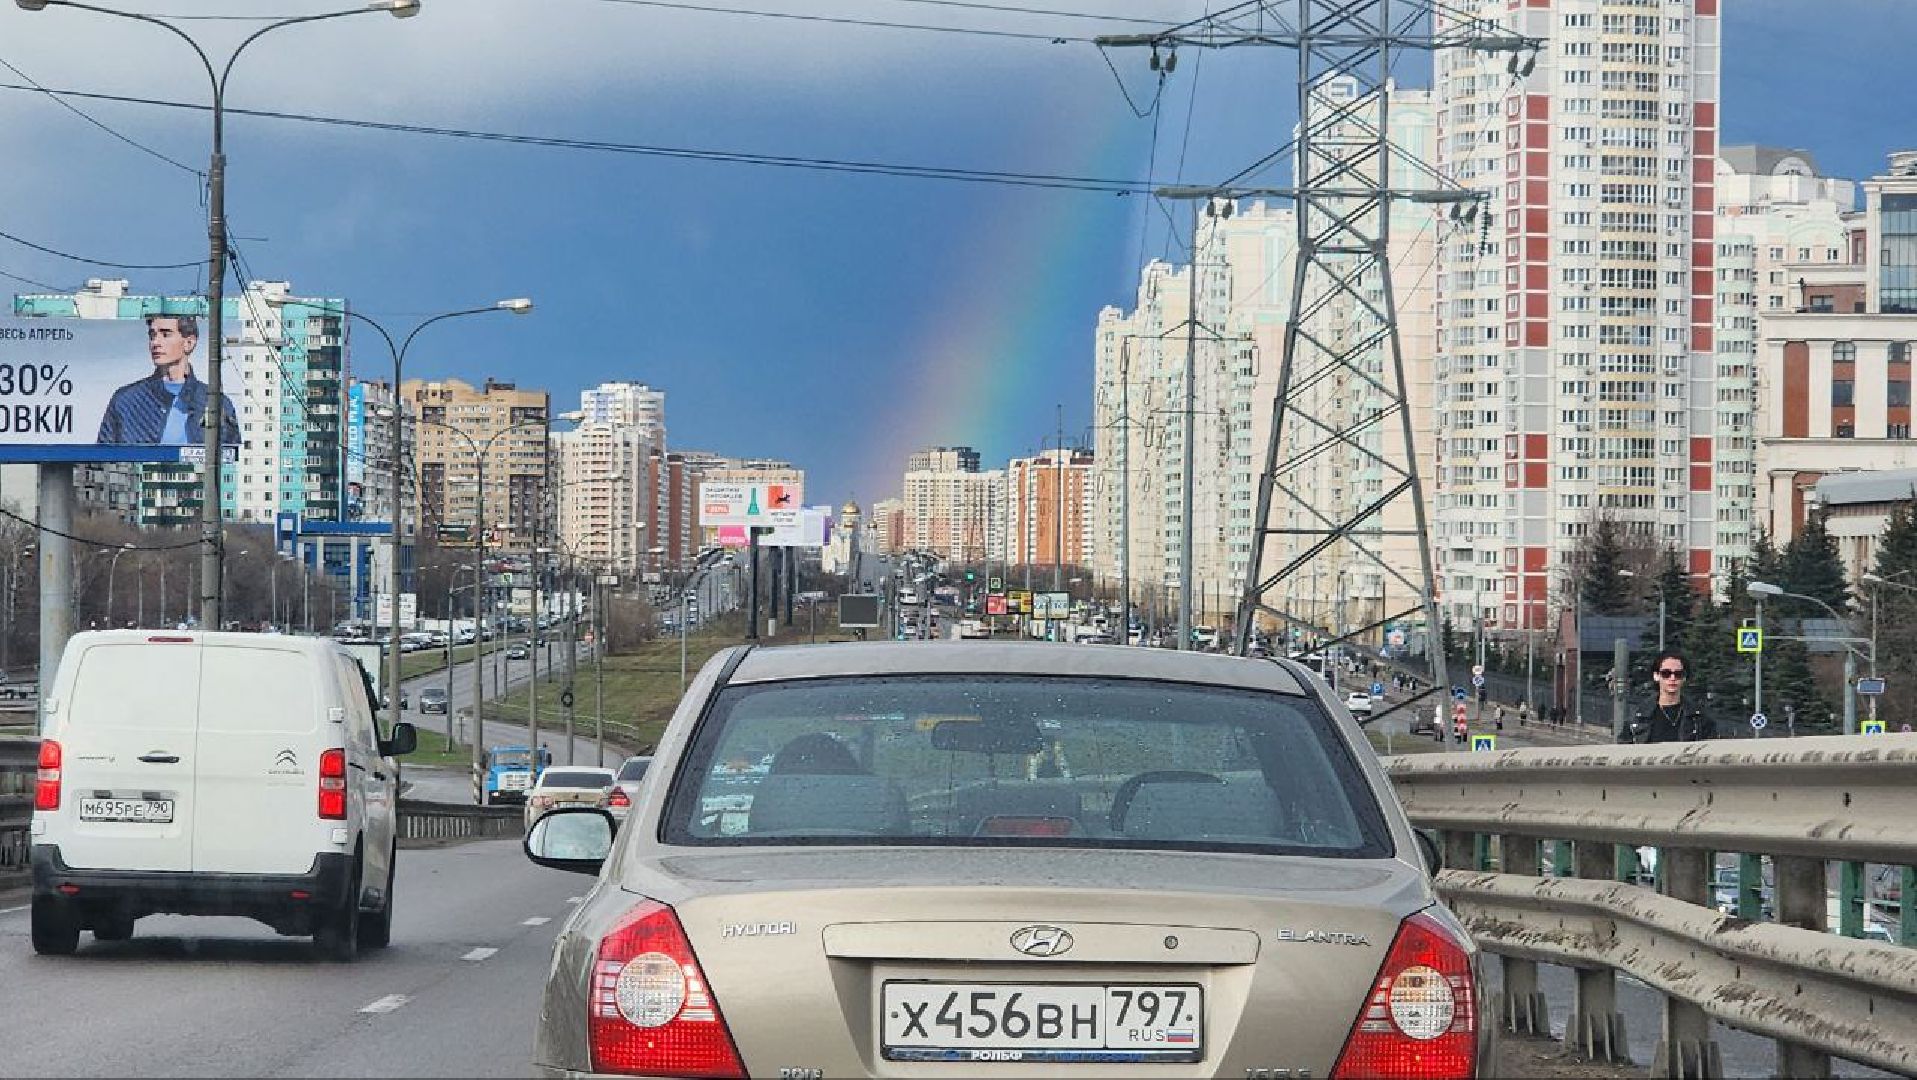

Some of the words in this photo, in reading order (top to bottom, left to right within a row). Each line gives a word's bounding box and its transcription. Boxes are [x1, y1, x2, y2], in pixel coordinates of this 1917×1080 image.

[29, 328, 73, 340] АПРЕЛЬ
[722, 921, 796, 937] HYUNDAI
[1277, 928, 1371, 946] ELANTRA
[1111, 990, 1187, 1027] 797
[1128, 1028, 1165, 1042] RUS
